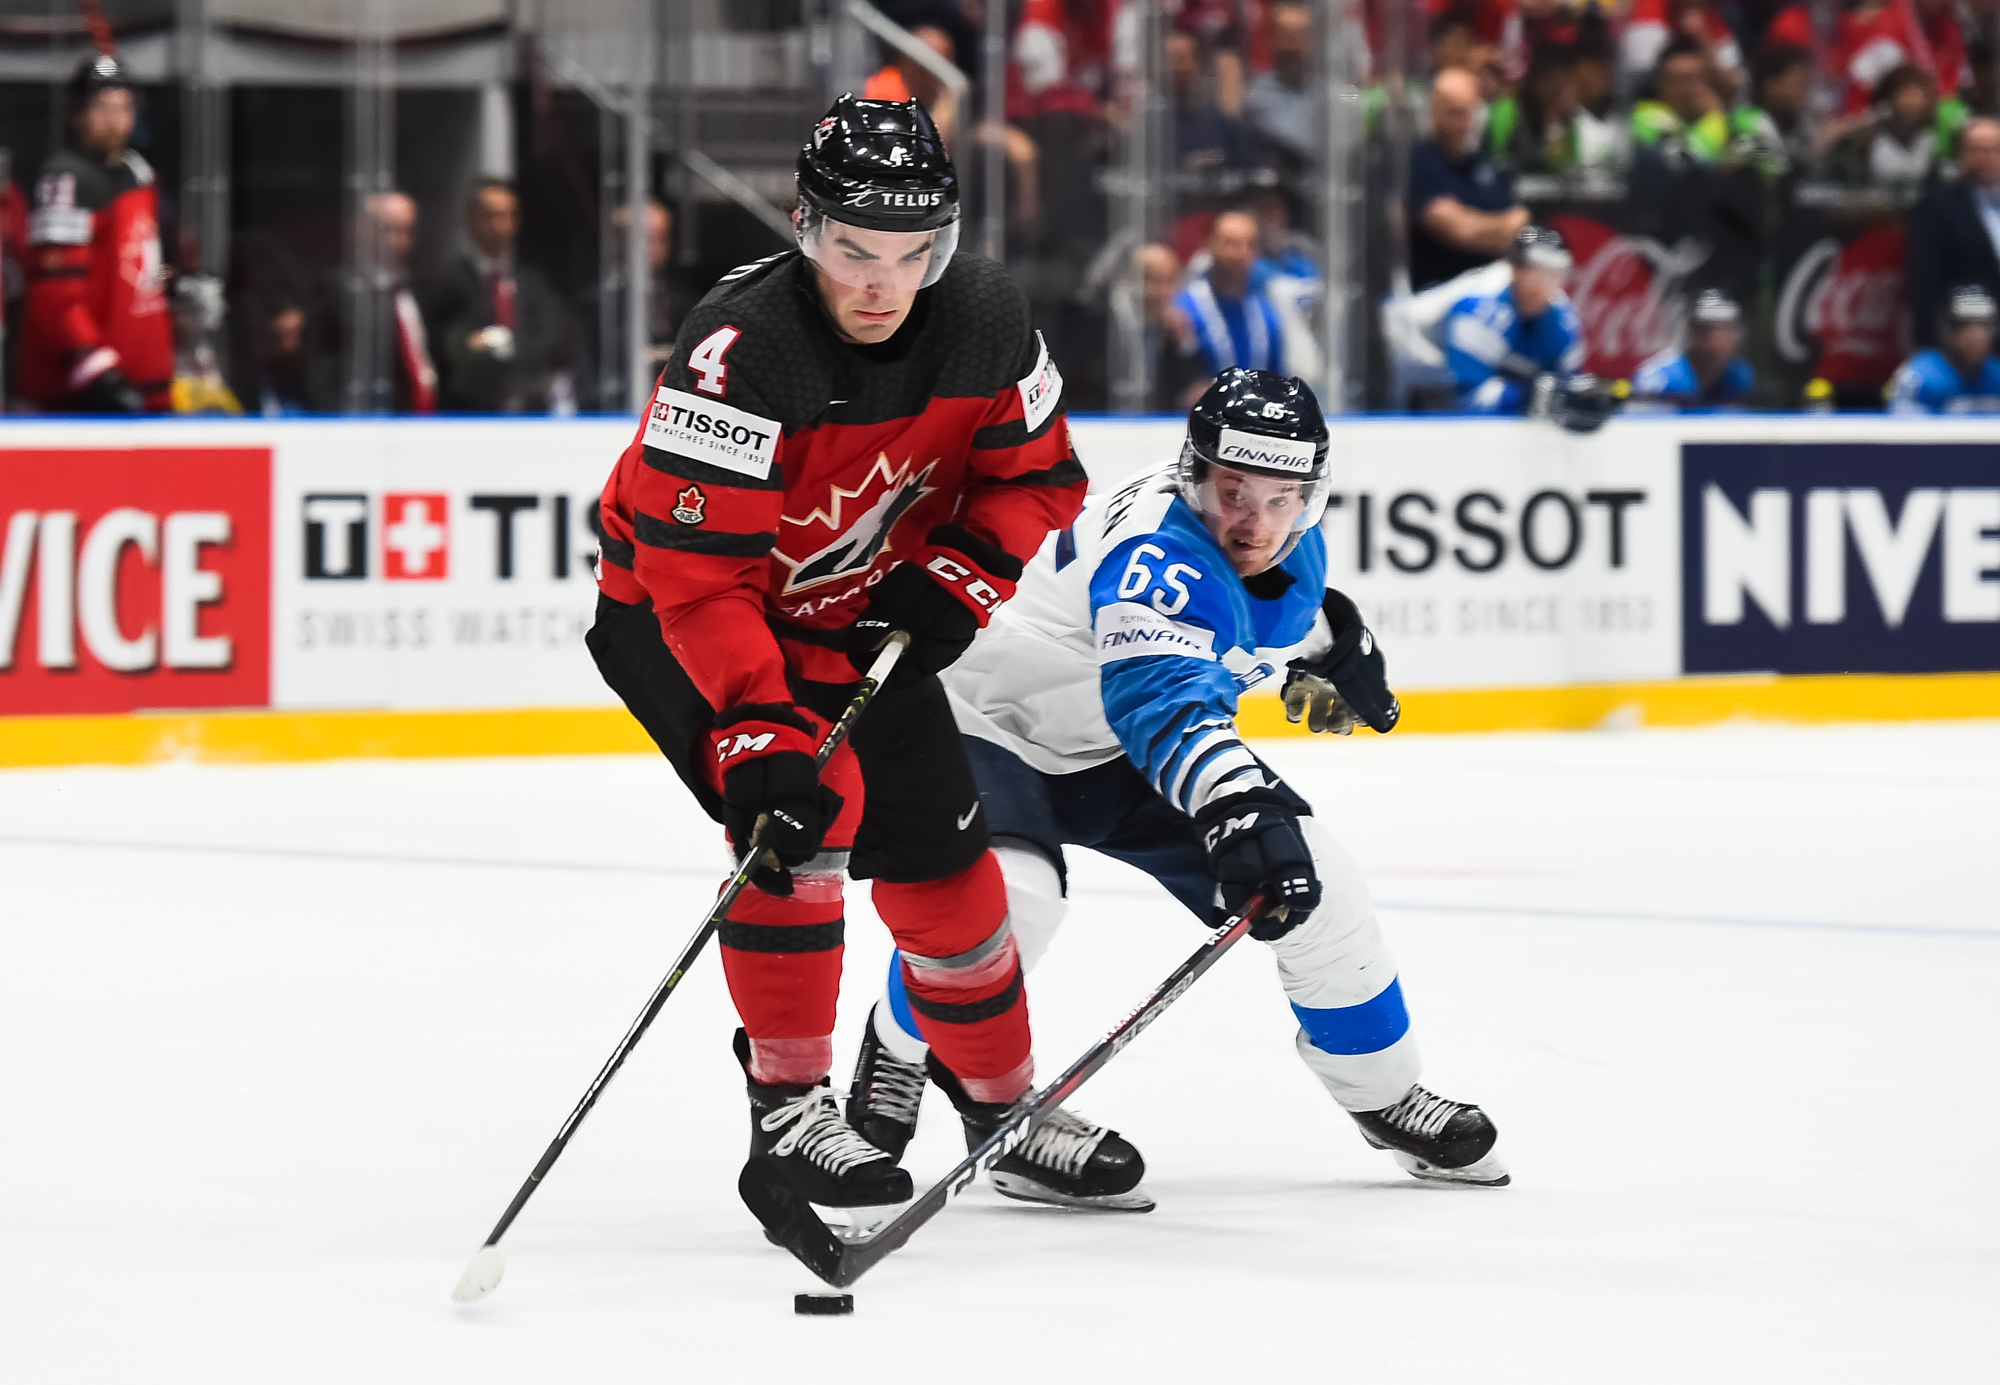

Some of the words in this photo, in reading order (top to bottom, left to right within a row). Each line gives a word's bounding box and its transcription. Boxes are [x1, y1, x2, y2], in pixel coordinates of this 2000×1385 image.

[889, 146, 908, 167] 4
[881, 193, 945, 207] TELUS
[688, 325, 742, 397] 4
[1262, 402, 1285, 420] 65
[671, 405, 770, 450] TISSOT
[1249, 438, 1274, 448] FLYING
[663, 428, 704, 446] WATCHES
[707, 440, 739, 456] SINCE
[743, 452, 766, 465] 1853
[1222, 445, 1310, 468] FINNAIR
[1702, 480, 2000, 630] NIVE
[1118, 542, 1203, 617] 65
[297, 608, 433, 649] SWISS
[855, 620, 891, 628] CCM
[1362, 598, 1441, 637] HES
[1457, 598, 1564, 637] SINCE
[1101, 628, 1203, 651] FINNAIR
[773, 808, 804, 831] CCM
[1205, 915, 1241, 947] CCM
[947, 1114, 1031, 1197] CCM
